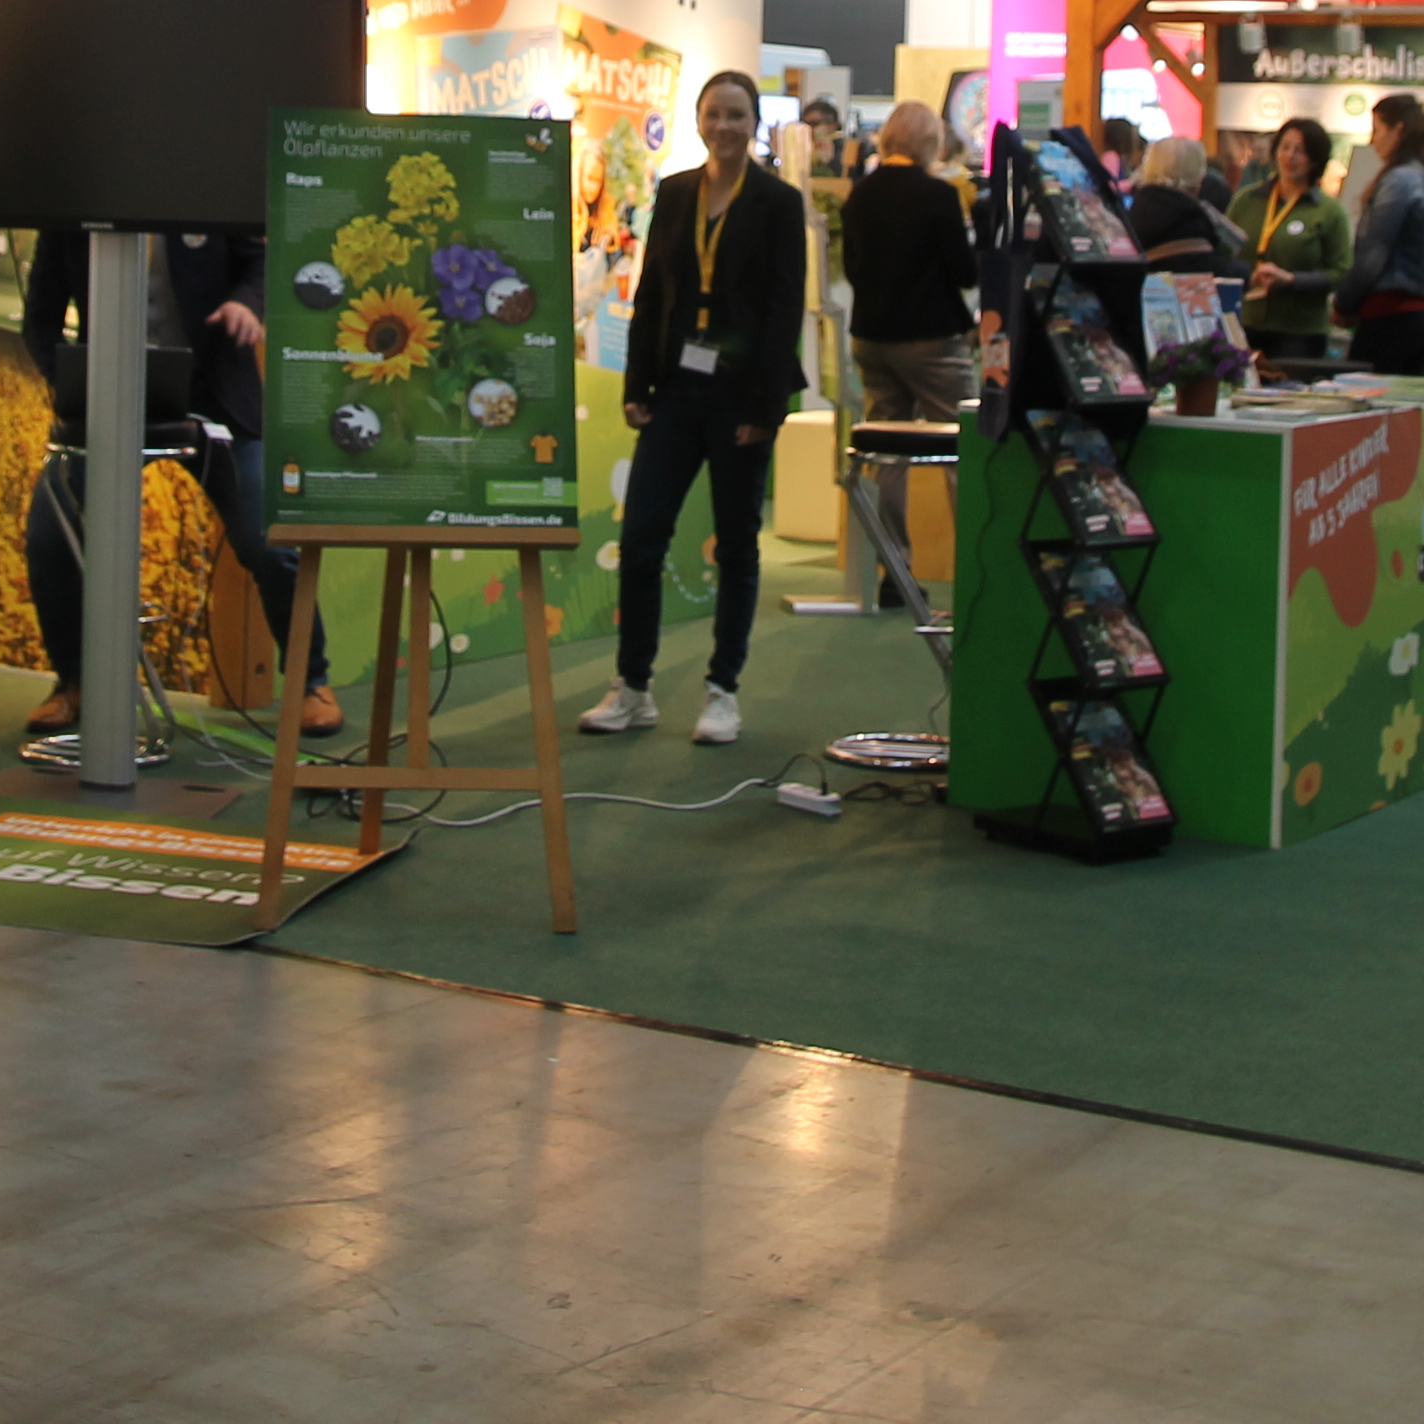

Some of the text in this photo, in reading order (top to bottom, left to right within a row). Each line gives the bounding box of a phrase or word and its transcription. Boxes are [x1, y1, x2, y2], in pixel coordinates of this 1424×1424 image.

[283, 120, 472, 143] Wir erkunden unsere
[283, 138, 384, 159] Ölpflanzen
[285, 172, 324, 188] Raps
[523, 208, 555, 221] Lein
[523, 333, 556, 347] Soja
[282, 346, 385, 362] Sonnenblume
